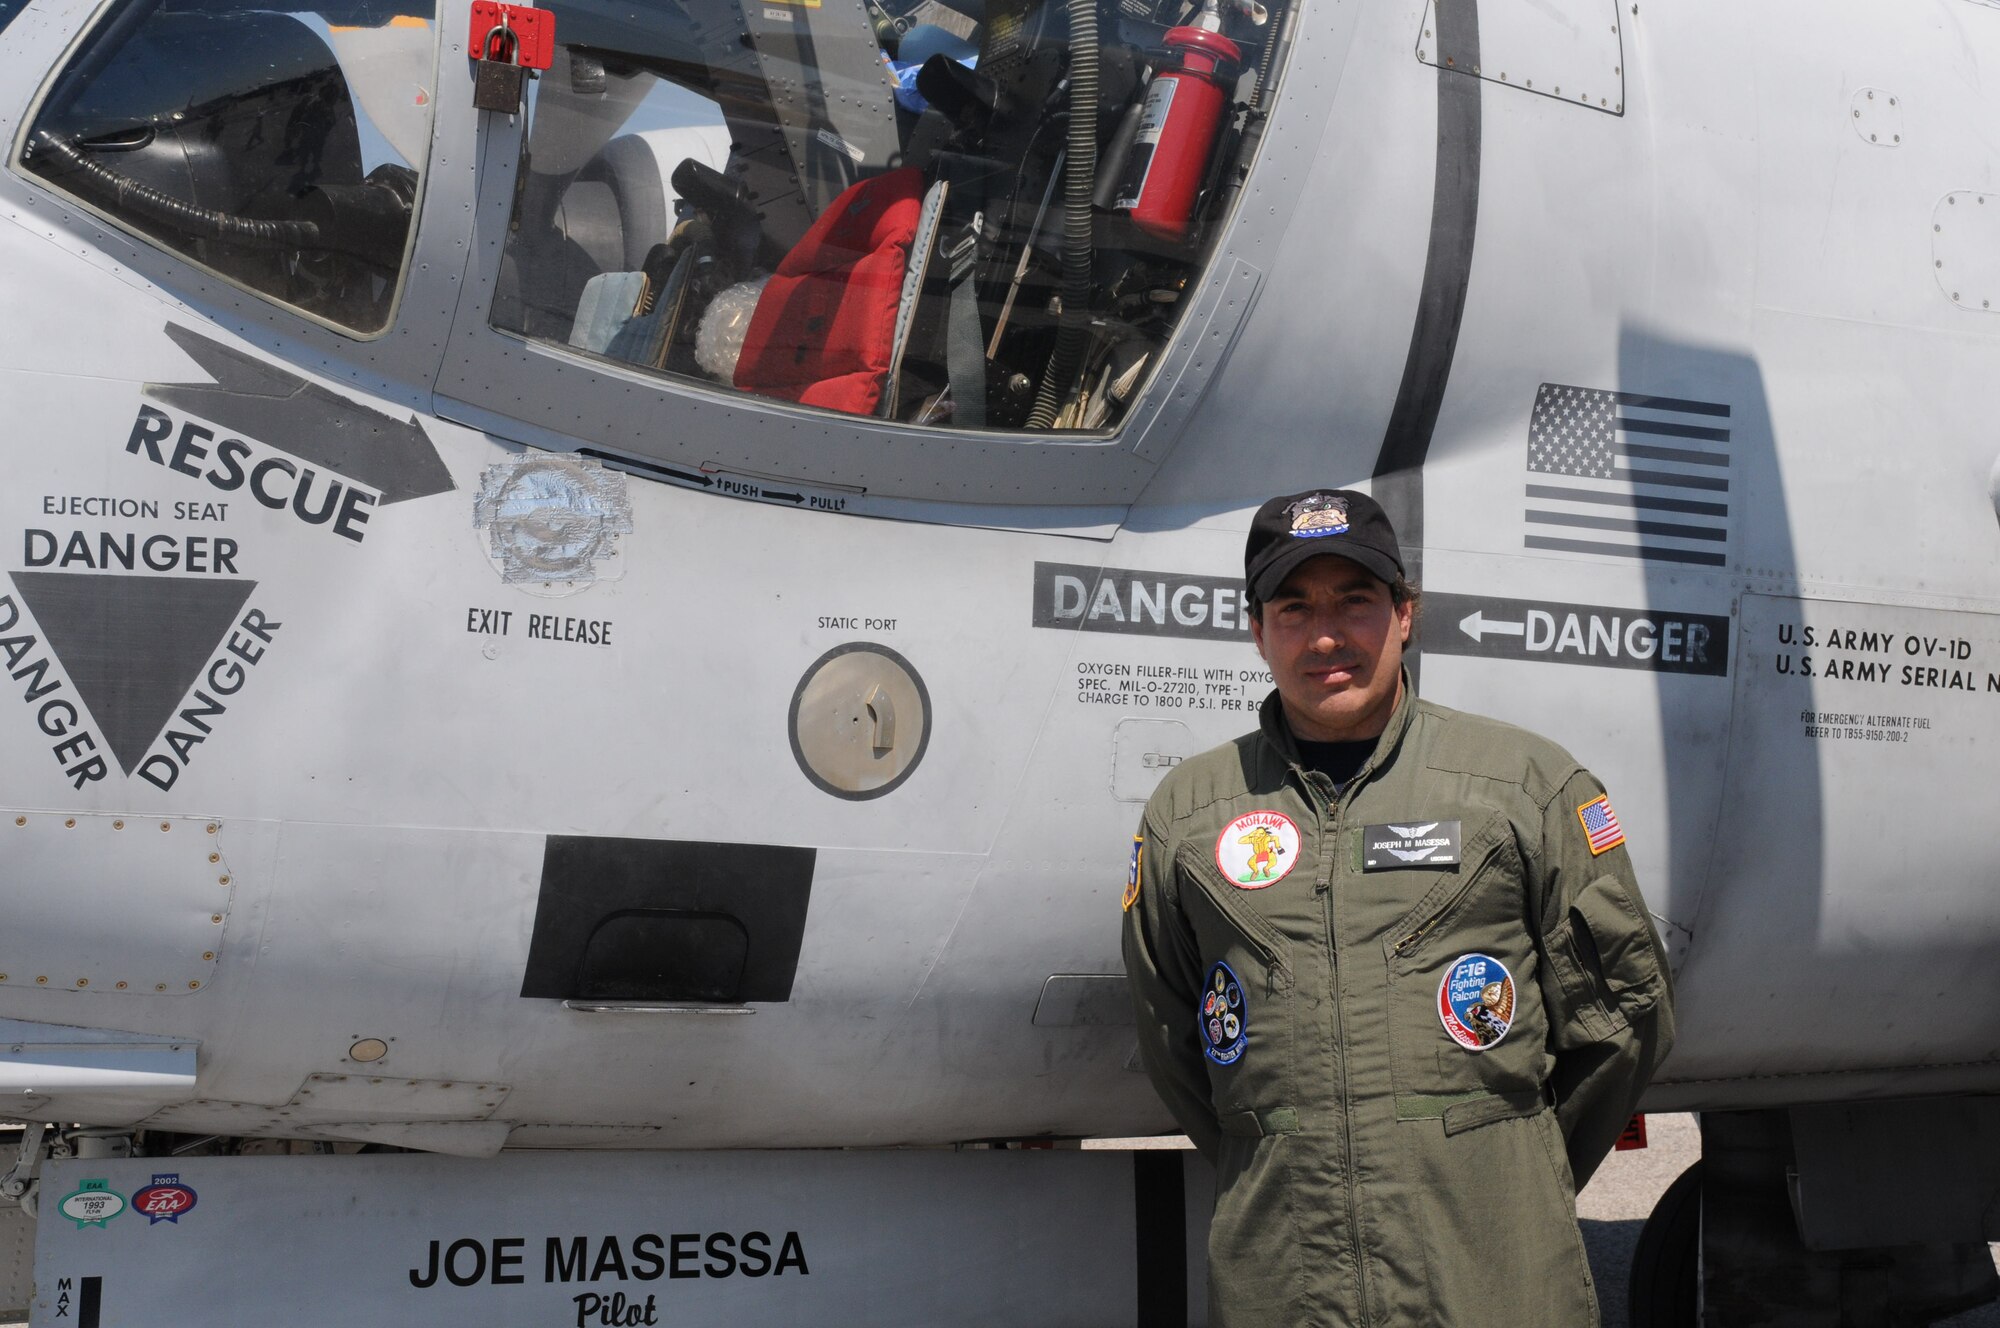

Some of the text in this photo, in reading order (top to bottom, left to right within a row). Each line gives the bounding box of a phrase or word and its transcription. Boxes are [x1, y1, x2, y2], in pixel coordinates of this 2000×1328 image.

[125, 403, 376, 543] RESCUE
[724, 481, 840, 510] PUSH PULL
[43, 496, 228, 522] EJECTION SEAT
[24, 528, 239, 574] DANGER
[467, 607, 613, 645] EXIT RELEASE
[818, 616, 897, 631] STATIC PORT
[1525, 609, 1710, 663] DANGER
[1778, 624, 1972, 660] U.S. ARMY OV-1D
[1077, 662, 1274, 684] OXYGEN FILLER-FILL WITH OXYG
[1776, 654, 1817, 677] U.S.
[1824, 659, 1892, 684] ARMY
[1900, 665, 1976, 692] SERIAL
[0, 594, 108, 791] DANGER
[1078, 678, 1111, 691] SPEC.
[136, 608, 282, 793] DANGER
[1078, 692, 1129, 705] CHARGE
[1133, 694, 1150, 706] TO
[1155, 696, 1183, 708] 1800
[1221, 699, 1242, 711] PER
[1801, 711, 1931, 729] FOR EMERGENCY ALTERNATE FUEL
[1805, 726, 1829, 738] REFER
[1832, 728, 1841, 739] TO
[1235, 815, 1287, 831] MOHAWK
[1373, 841, 1401, 850] JOSEPH
[1415, 838, 1450, 847] MASESSA
[1456, 961, 1487, 979] F-16
[1451, 977, 1486, 992] Fighting
[1451, 991, 1480, 1003] Falcon
[154, 1177, 178, 1185] 2002
[84, 1201, 105, 1210] 1993
[145, 1199, 179, 1211] EAA
[409, 1231, 810, 1288] JOE MASESSA
[56, 1277, 71, 1317] MAX
[573, 1292, 658, 1328] Pilot
